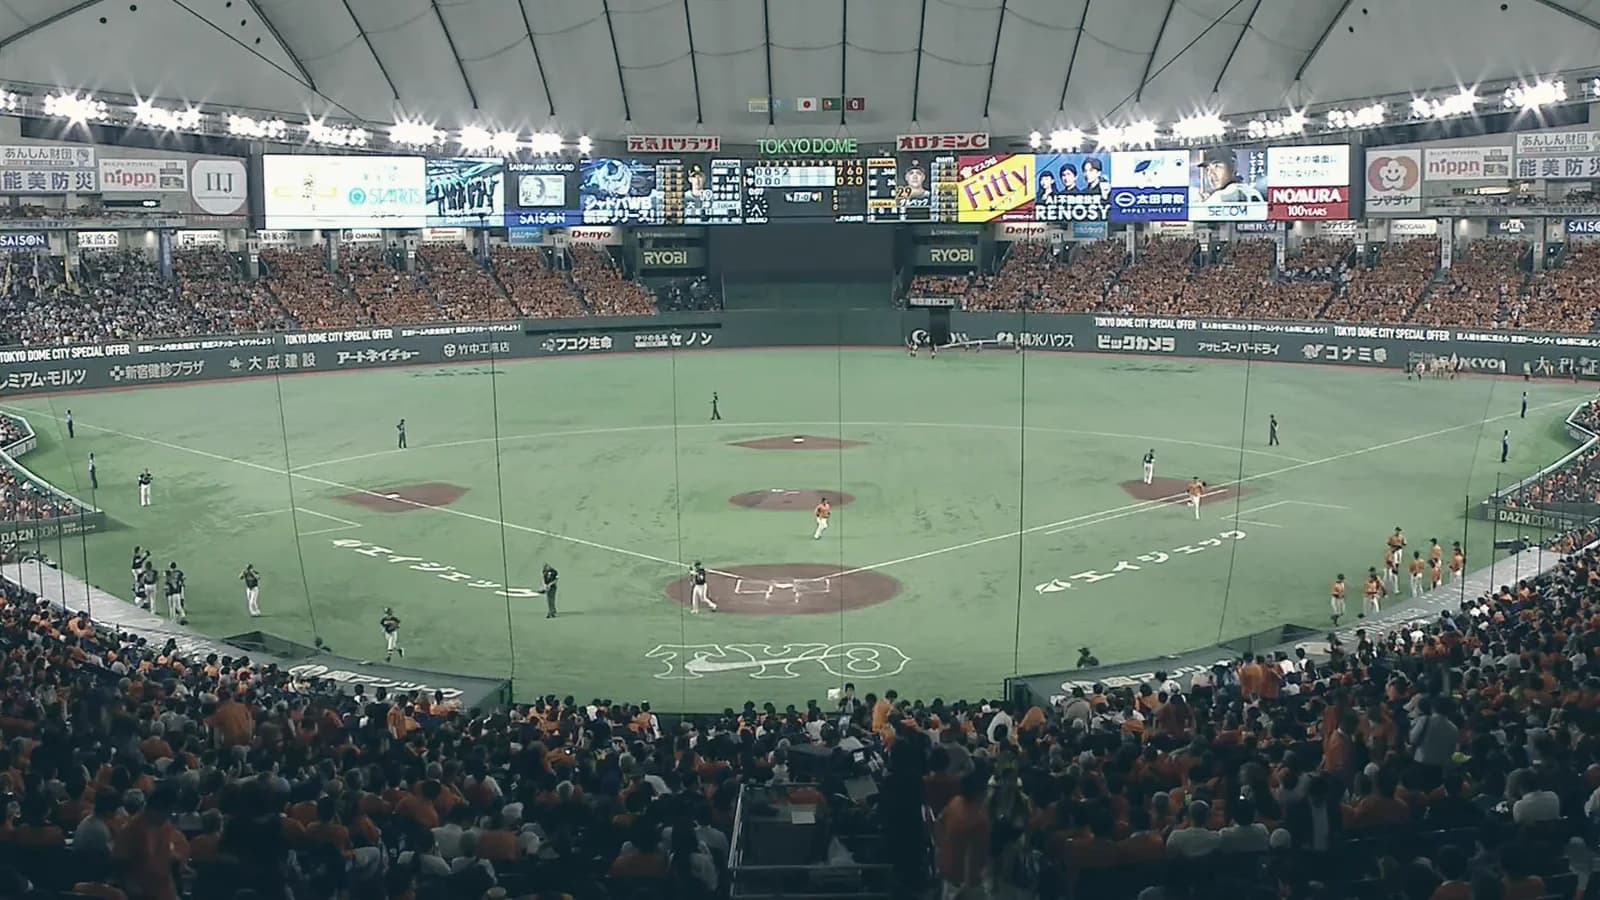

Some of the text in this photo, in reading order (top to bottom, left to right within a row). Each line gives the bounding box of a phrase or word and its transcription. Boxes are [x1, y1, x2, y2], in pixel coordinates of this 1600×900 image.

[630, 137, 718, 150] 元気ハツラツ!
[757, 138, 858, 154] TOKYO DOME
[900, 134, 986, 149] オロナミンC
[1429, 159, 1480, 176] nippn
[3, 171, 93, 190] 能美防災
[104, 169, 156, 186] nippn
[964, 165, 1028, 211] Fitty
[1273, 188, 1342, 204] NOMURA
[1036, 204, 1111, 221] RENOSY
[1208, 206, 1247, 216] SECOM
[571, 229, 611, 240] Denyo
[1005, 226, 1045, 236] Denyo
[0, 235, 45, 246] SAISON
[643, 251, 687, 265] RYOBI
[930, 248, 974, 262] RYOBI
[1095, 317, 1197, 330] TOKYO DOME CITY SPECIAL OFFER
[284, 329, 393, 345] TOKYO DOME CITY SPECIAL OFFER
[1334, 326, 1450, 341] TOKYO DOME CITY SPECIAL OFFER
[556, 336, 612, 350] フコク生命
[1097, 334, 1175, 351] ビックカメラ
[0, 344, 130, 363] TOKYO DOME CITY SPECIAL OFFER
[248, 352, 316, 371] 大成建設
[337, 348, 420, 365] アートネイチャー
